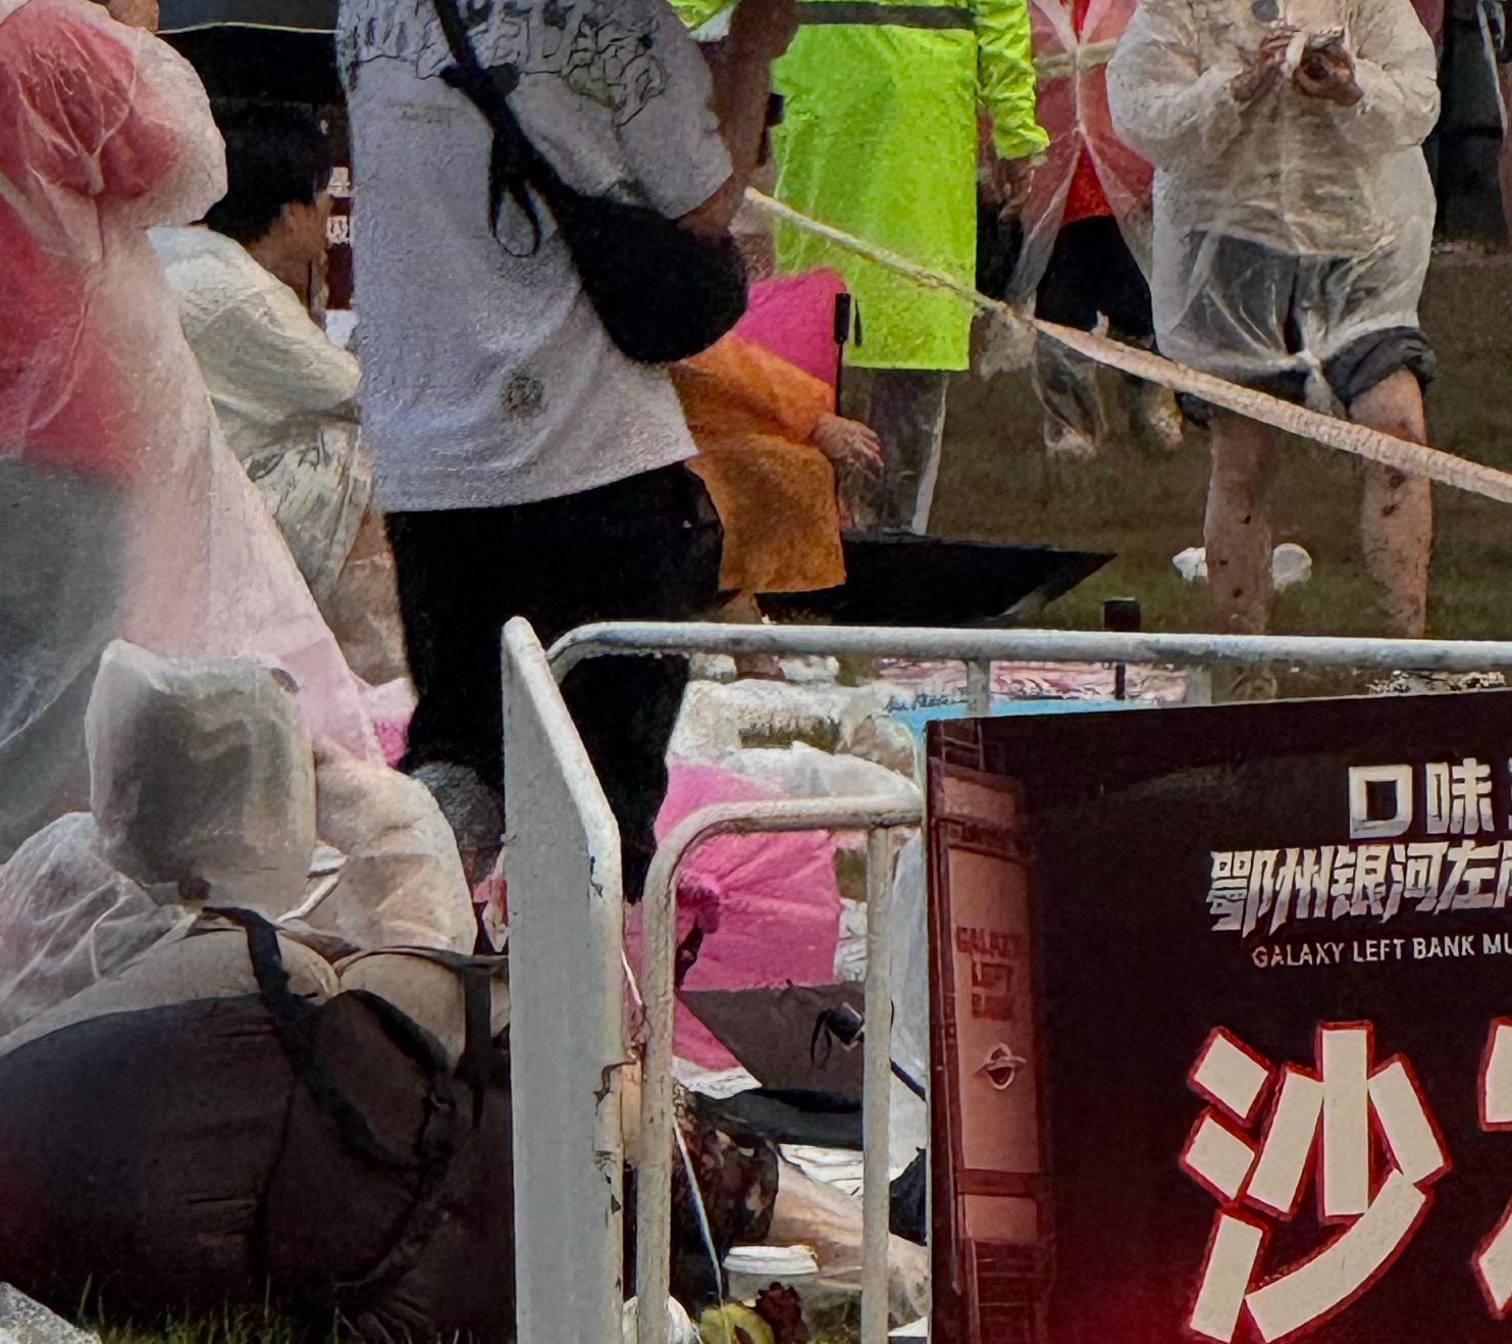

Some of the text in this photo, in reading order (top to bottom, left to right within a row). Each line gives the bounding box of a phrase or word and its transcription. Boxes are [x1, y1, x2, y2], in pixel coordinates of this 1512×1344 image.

[1349, 757, 1512, 839] 口味
[1205, 839, 1512, 938] 鄂州银河左
[1251, 941, 1345, 968] GALAXY
[1352, 938, 1406, 963] LEFT
[1412, 935, 1475, 960] BANK
[1183, 1019, 1512, 1344] 沙
